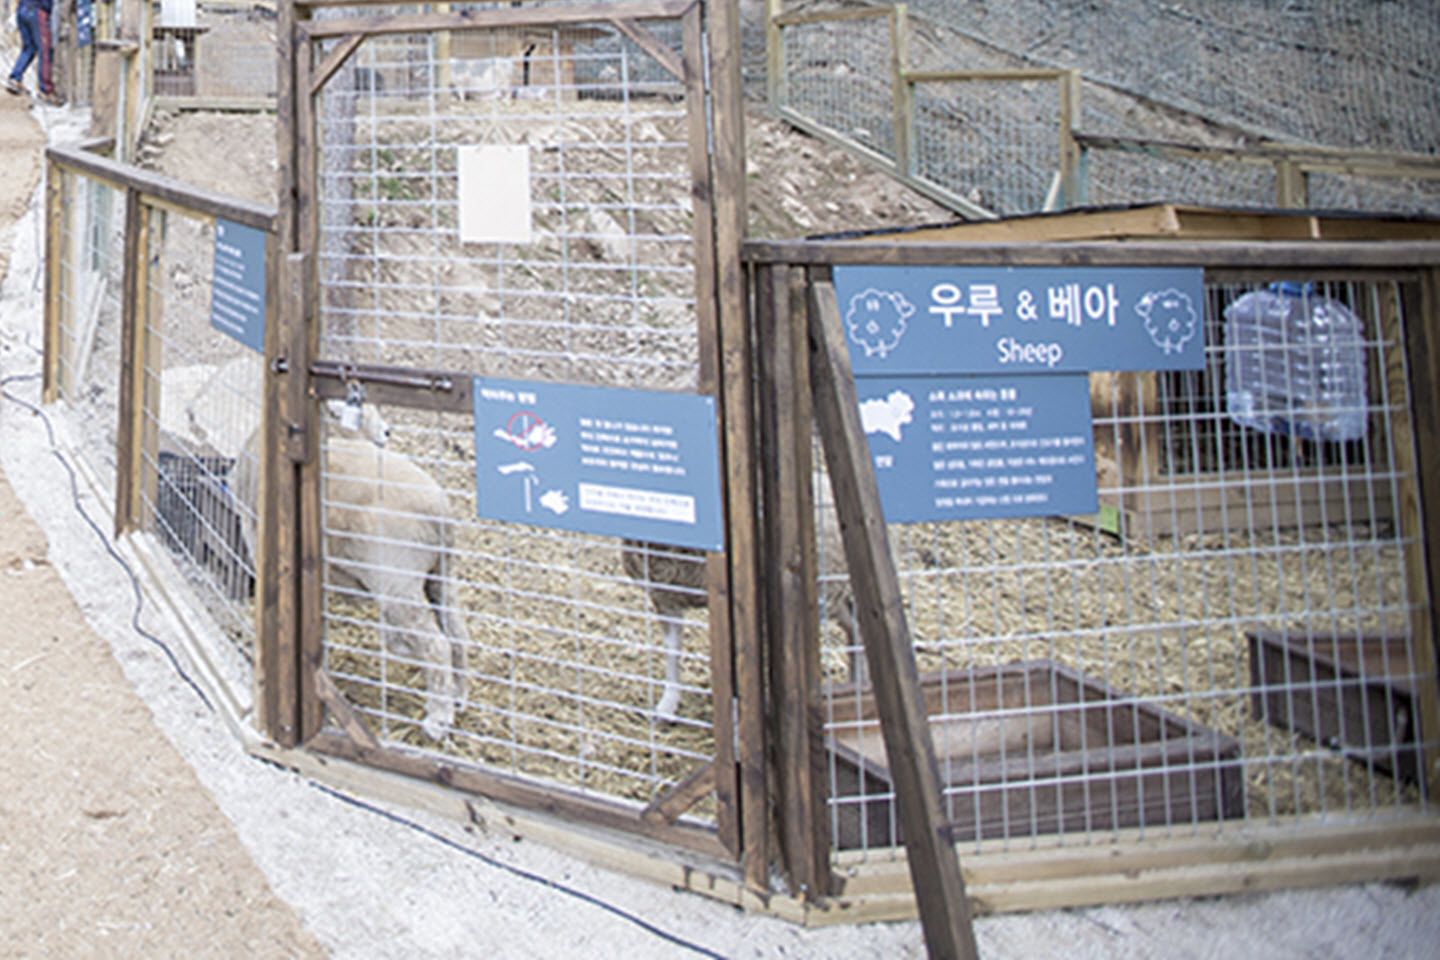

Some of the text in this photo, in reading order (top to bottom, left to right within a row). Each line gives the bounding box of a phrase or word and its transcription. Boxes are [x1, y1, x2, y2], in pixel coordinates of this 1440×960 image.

[927, 283, 1120, 328] 우루 & 베아
[996, 337, 1063, 367] Sheep
